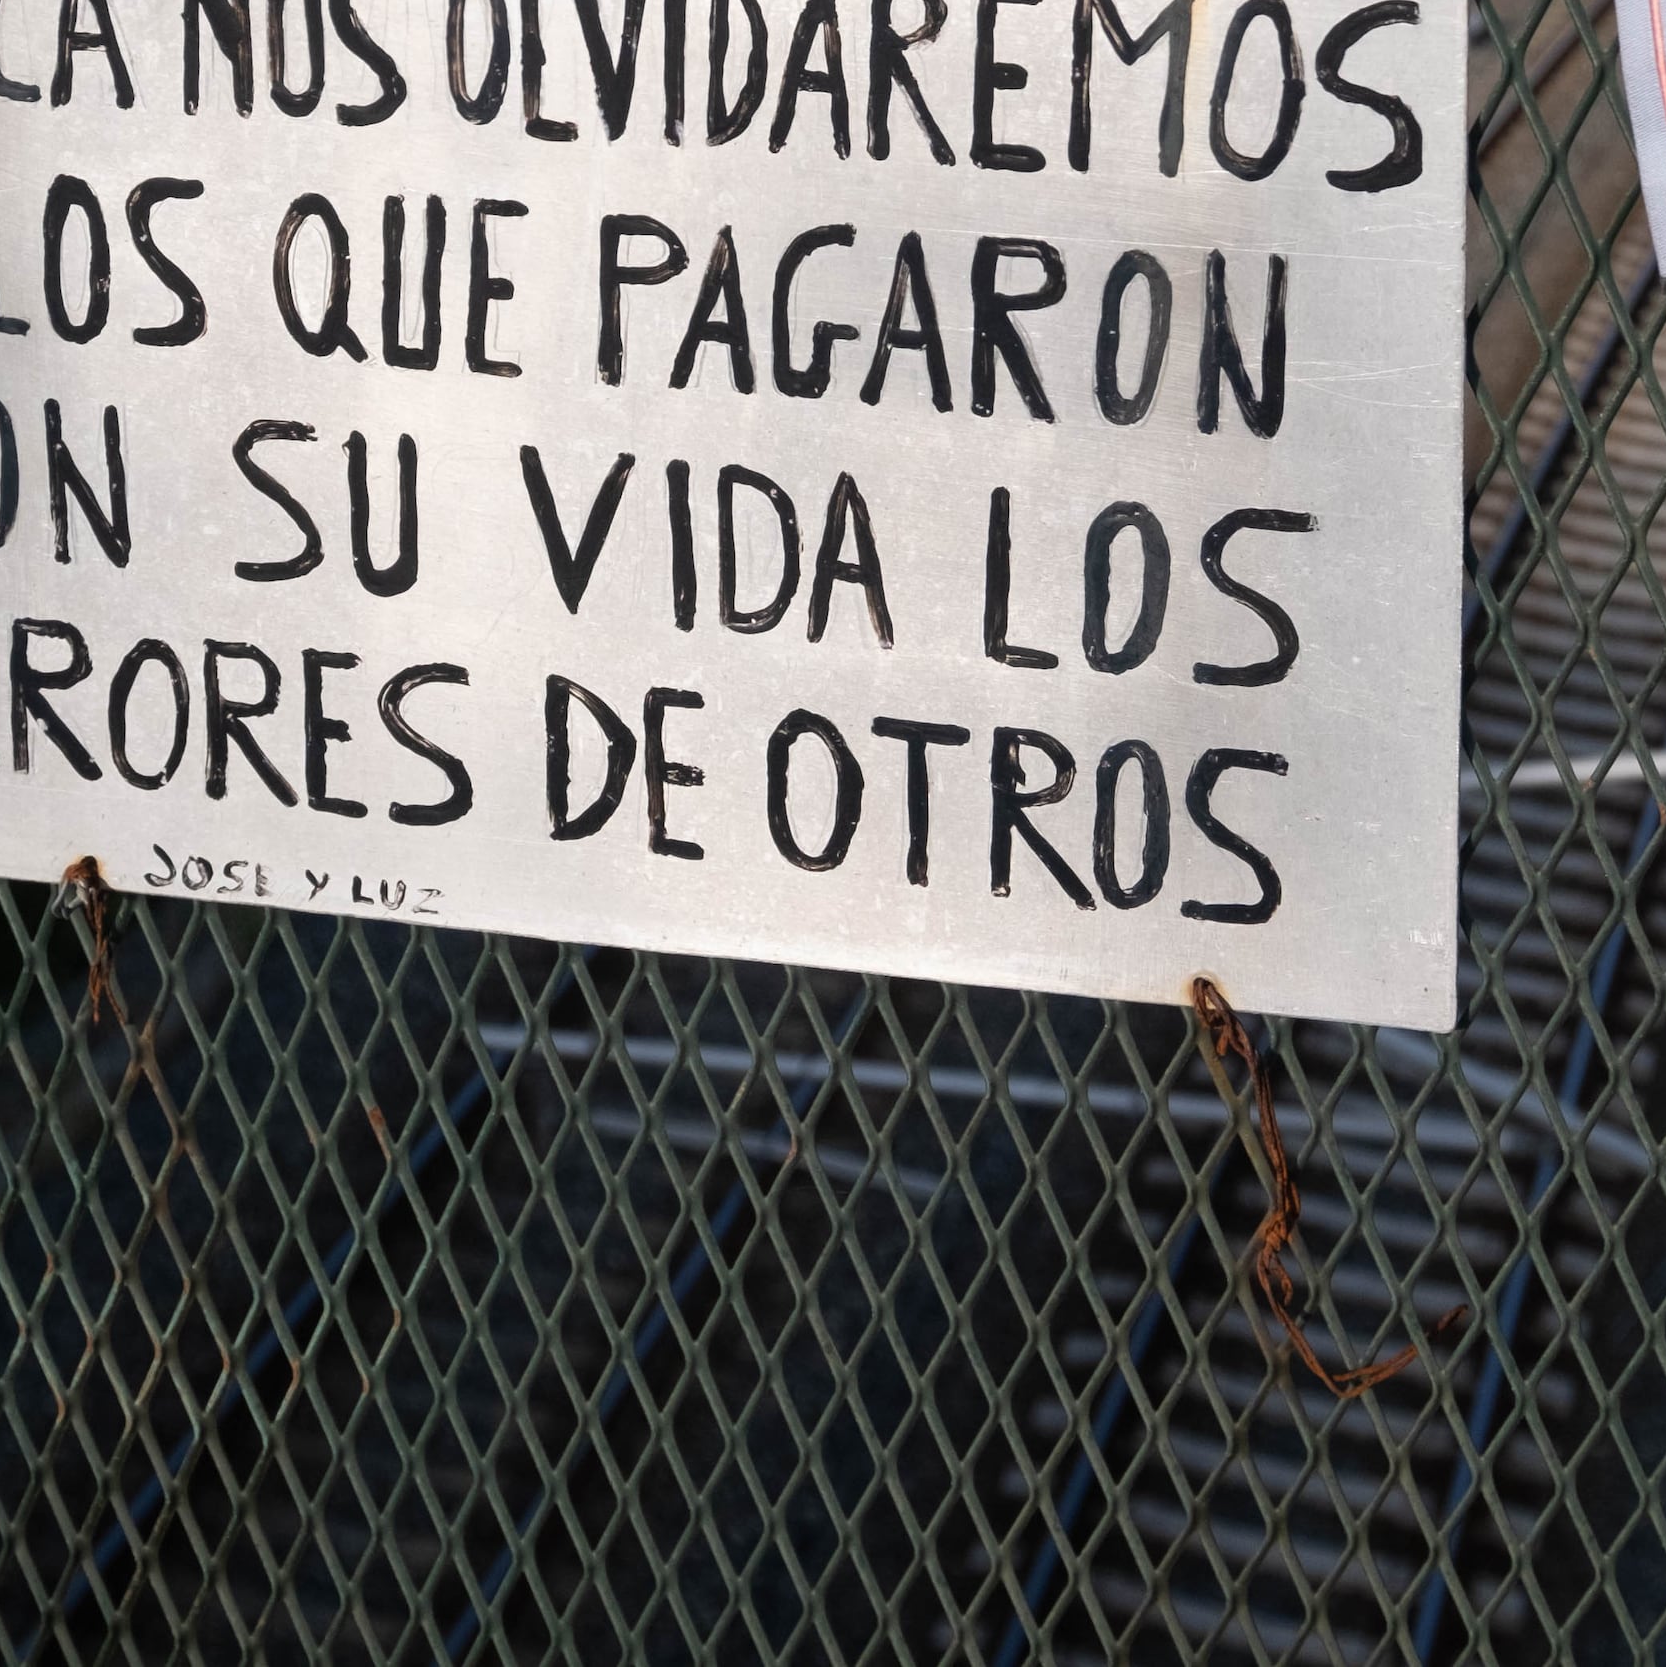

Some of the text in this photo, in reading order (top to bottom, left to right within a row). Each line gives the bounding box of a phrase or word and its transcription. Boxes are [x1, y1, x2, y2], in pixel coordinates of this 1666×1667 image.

[273, 193, 528, 377] QUE
[598, 214, 1287, 439] PAGARON
[233, 420, 418, 597] SU
[520, 445, 894, 644] VIDA
[984, 487, 1314, 687] LOS
[143, 843, 445, 916] JOSE Y LUZ
[545, 675, 705, 860] DE
[767, 709, 1289, 924] OTROS
